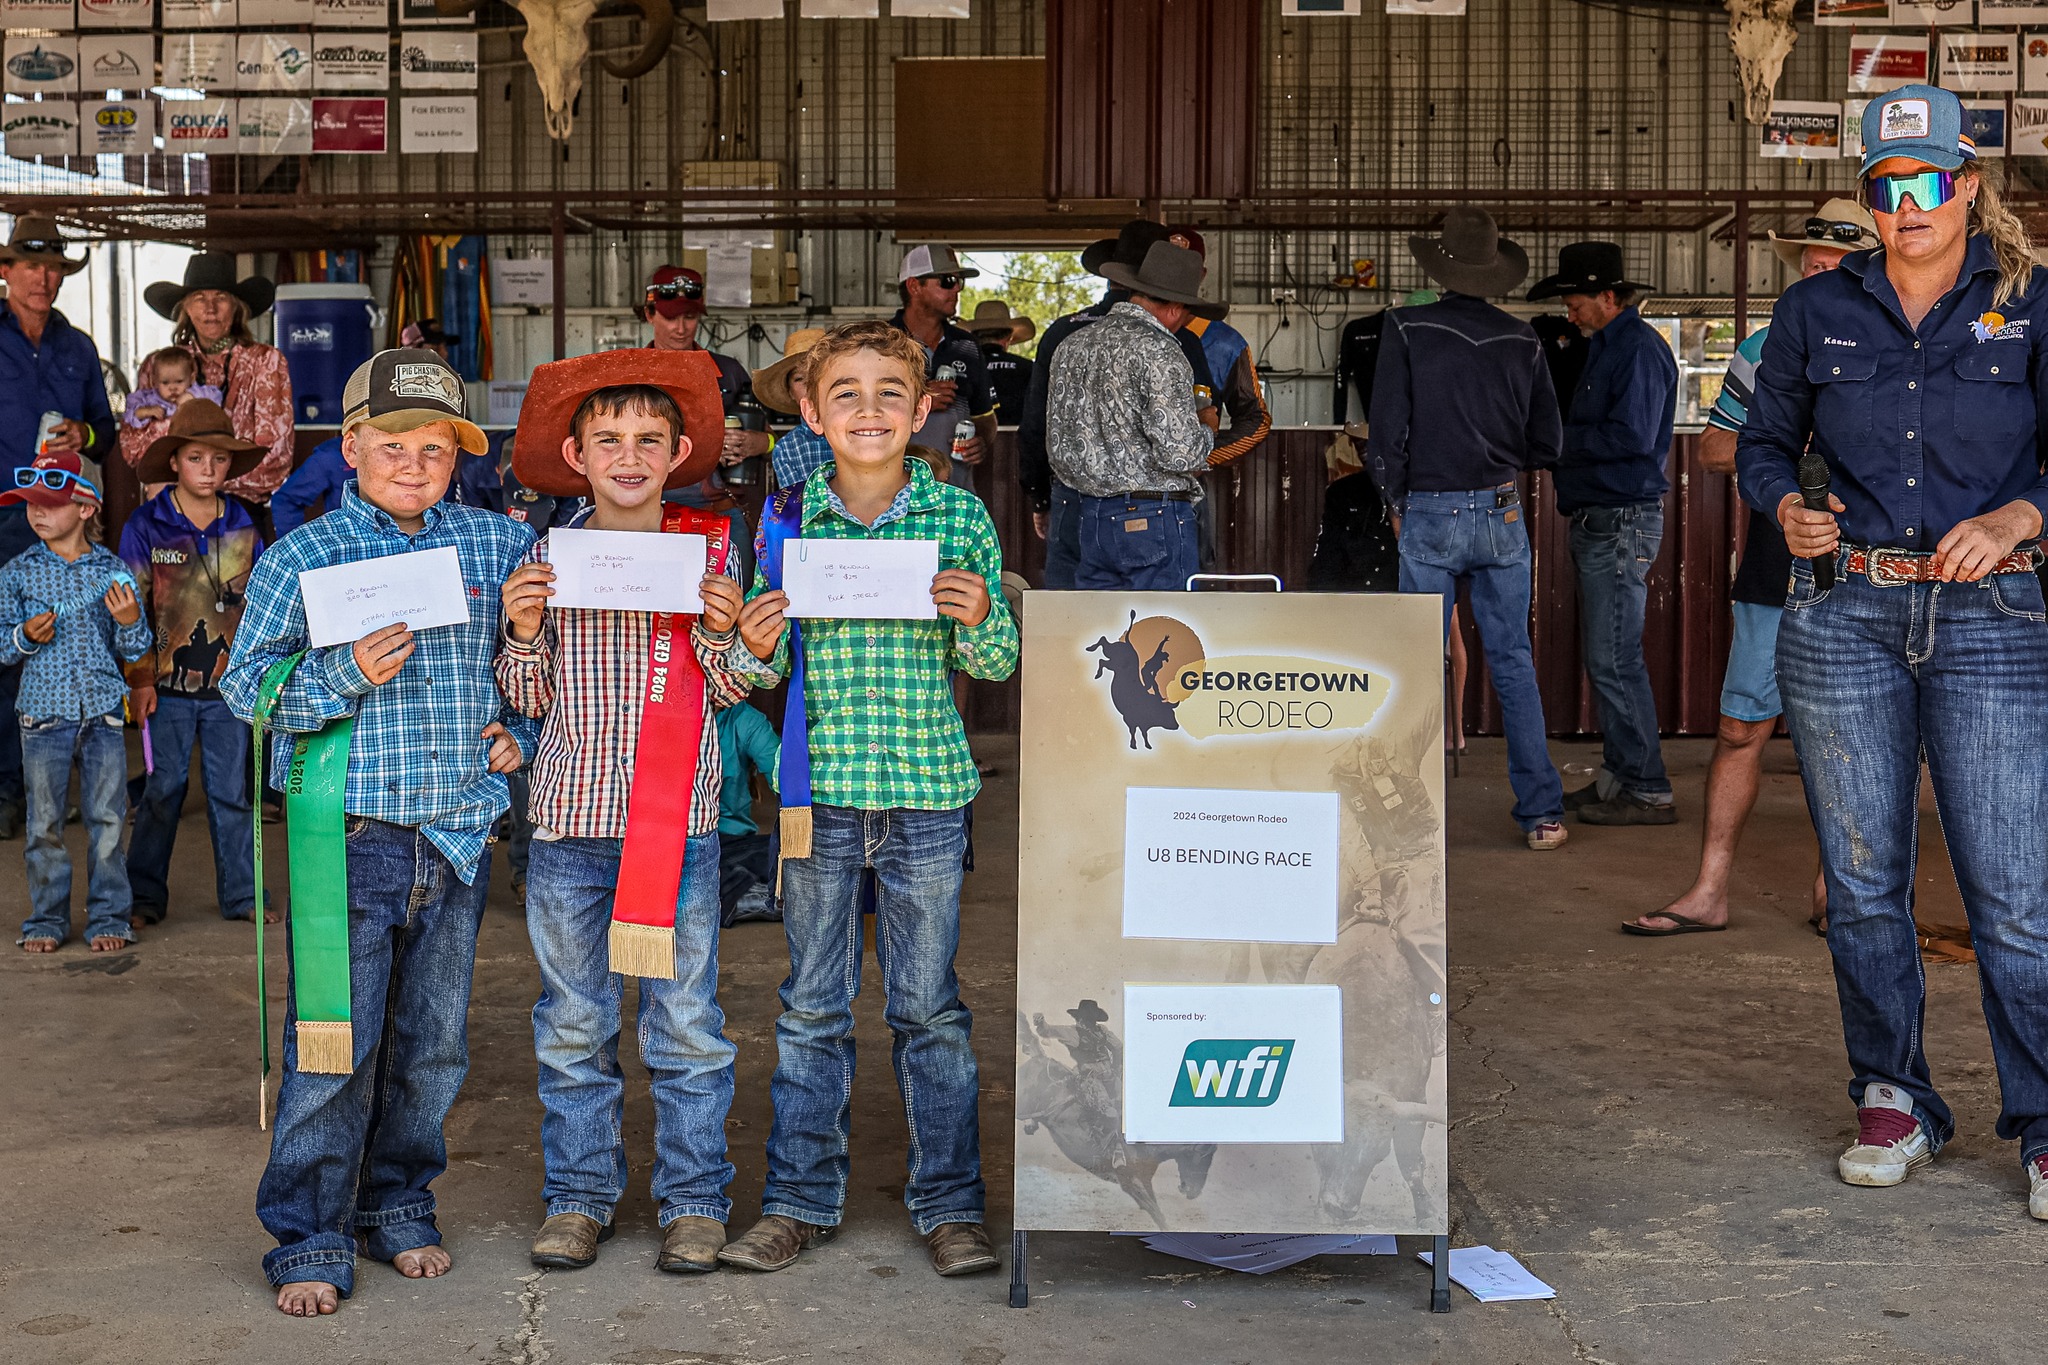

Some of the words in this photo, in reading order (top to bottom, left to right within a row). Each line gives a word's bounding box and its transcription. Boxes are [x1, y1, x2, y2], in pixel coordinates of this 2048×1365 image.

[411, 105, 428, 114] Fox
[430, 105, 466, 114] Electrics
[4, 115, 74, 131] CURLEY
[1769, 115, 1836, 129] WILKINSONS
[401, 366, 413, 376] PIG
[414, 366, 440, 377] CHASING
[594, 585, 614, 593] CASH
[361, 612, 386, 626] ETHAN
[650, 666, 668, 704] 2024
[1180, 670, 1369, 692] GEORGETOWN
[1218, 700, 1333, 729] RODEO
[289, 759, 306, 795] 2024
[1173, 811, 1197, 821] 2024
[1198, 812, 1255, 824] Georgetown
[1257, 814, 1288, 824] Rodeo
[1147, 847, 1171, 863] U8
[1176, 848, 1260, 866] BENDING
[1264, 851, 1312, 867] RACE
[1146, 1012, 1192, 1022] Sponsored
[1194, 1012, 1207, 1022] by:
[1185, 1046, 1284, 1098] wfi
